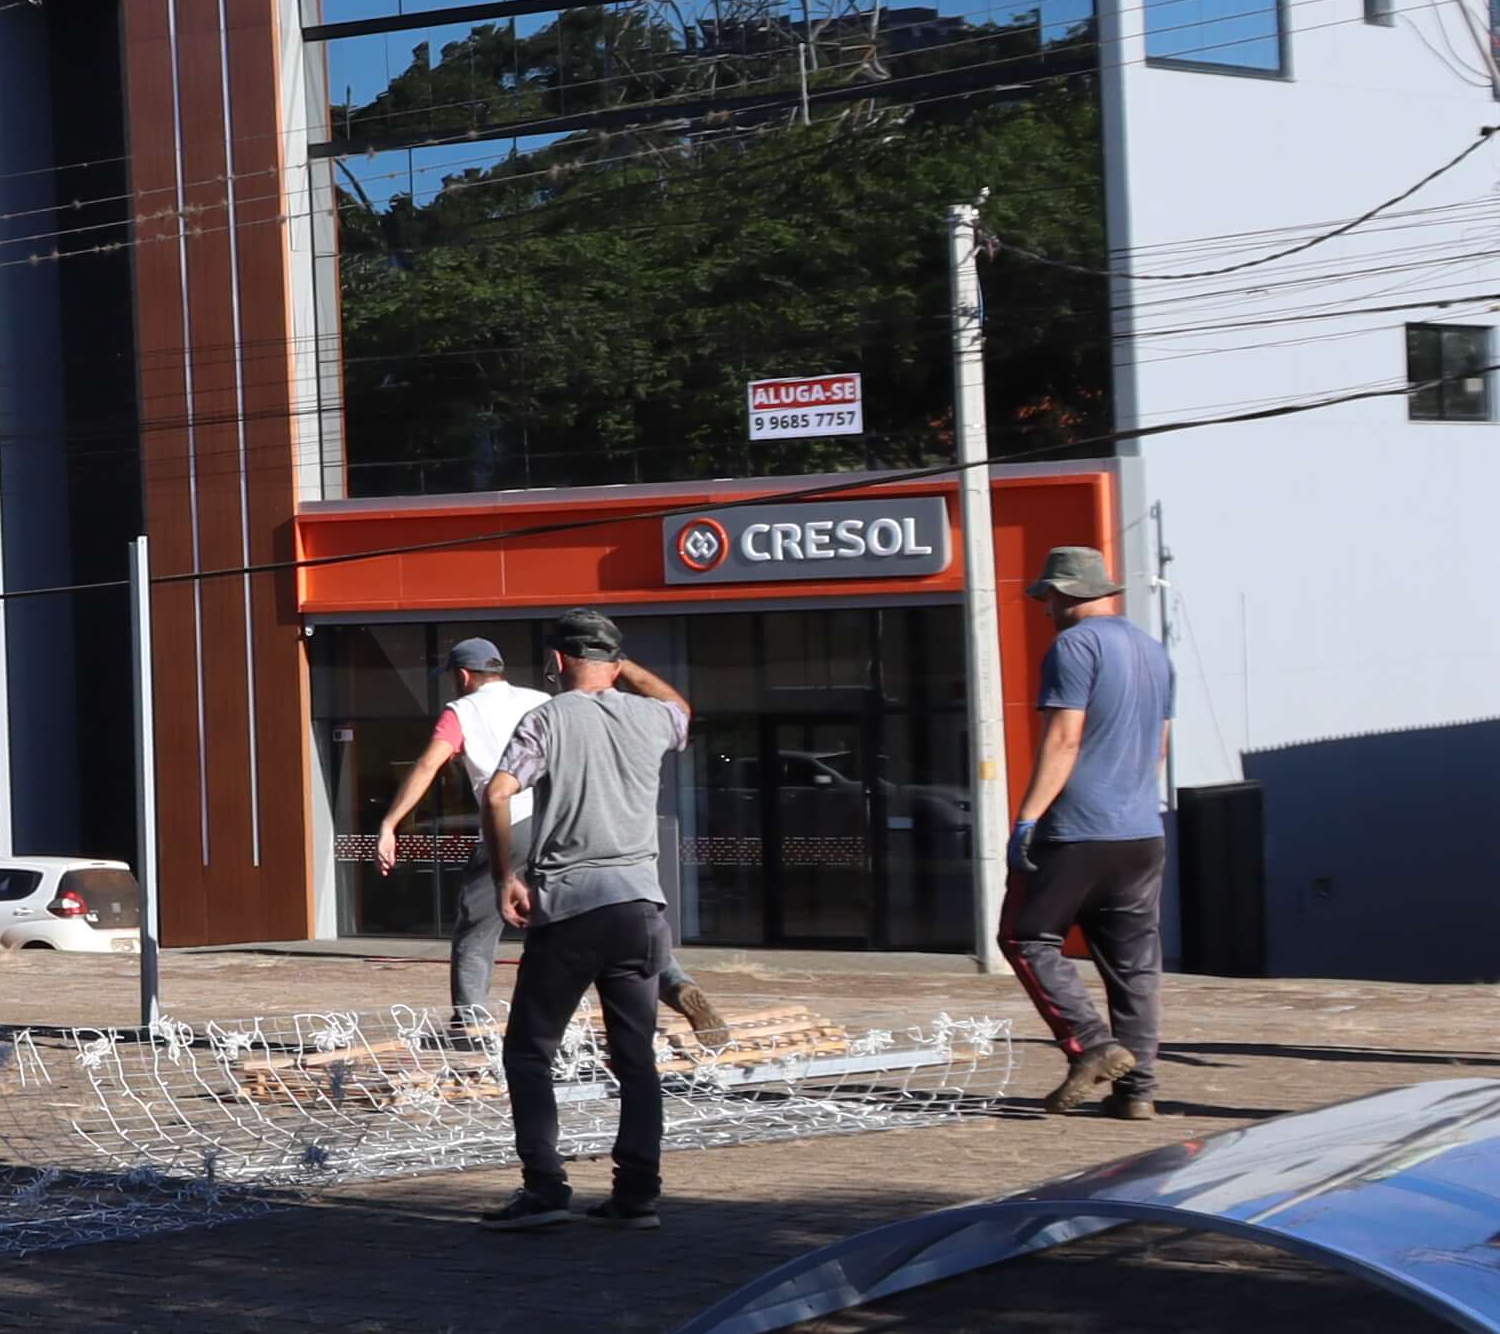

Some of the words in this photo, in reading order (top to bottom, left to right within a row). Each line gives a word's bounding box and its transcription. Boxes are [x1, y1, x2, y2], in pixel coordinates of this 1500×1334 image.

[753, 382, 856, 405] ALUGA-SE
[754, 417, 765, 431] 9
[770, 413, 810, 429] 9685
[815, 410, 856, 427] 7757
[741, 518, 932, 561] CRESOL
